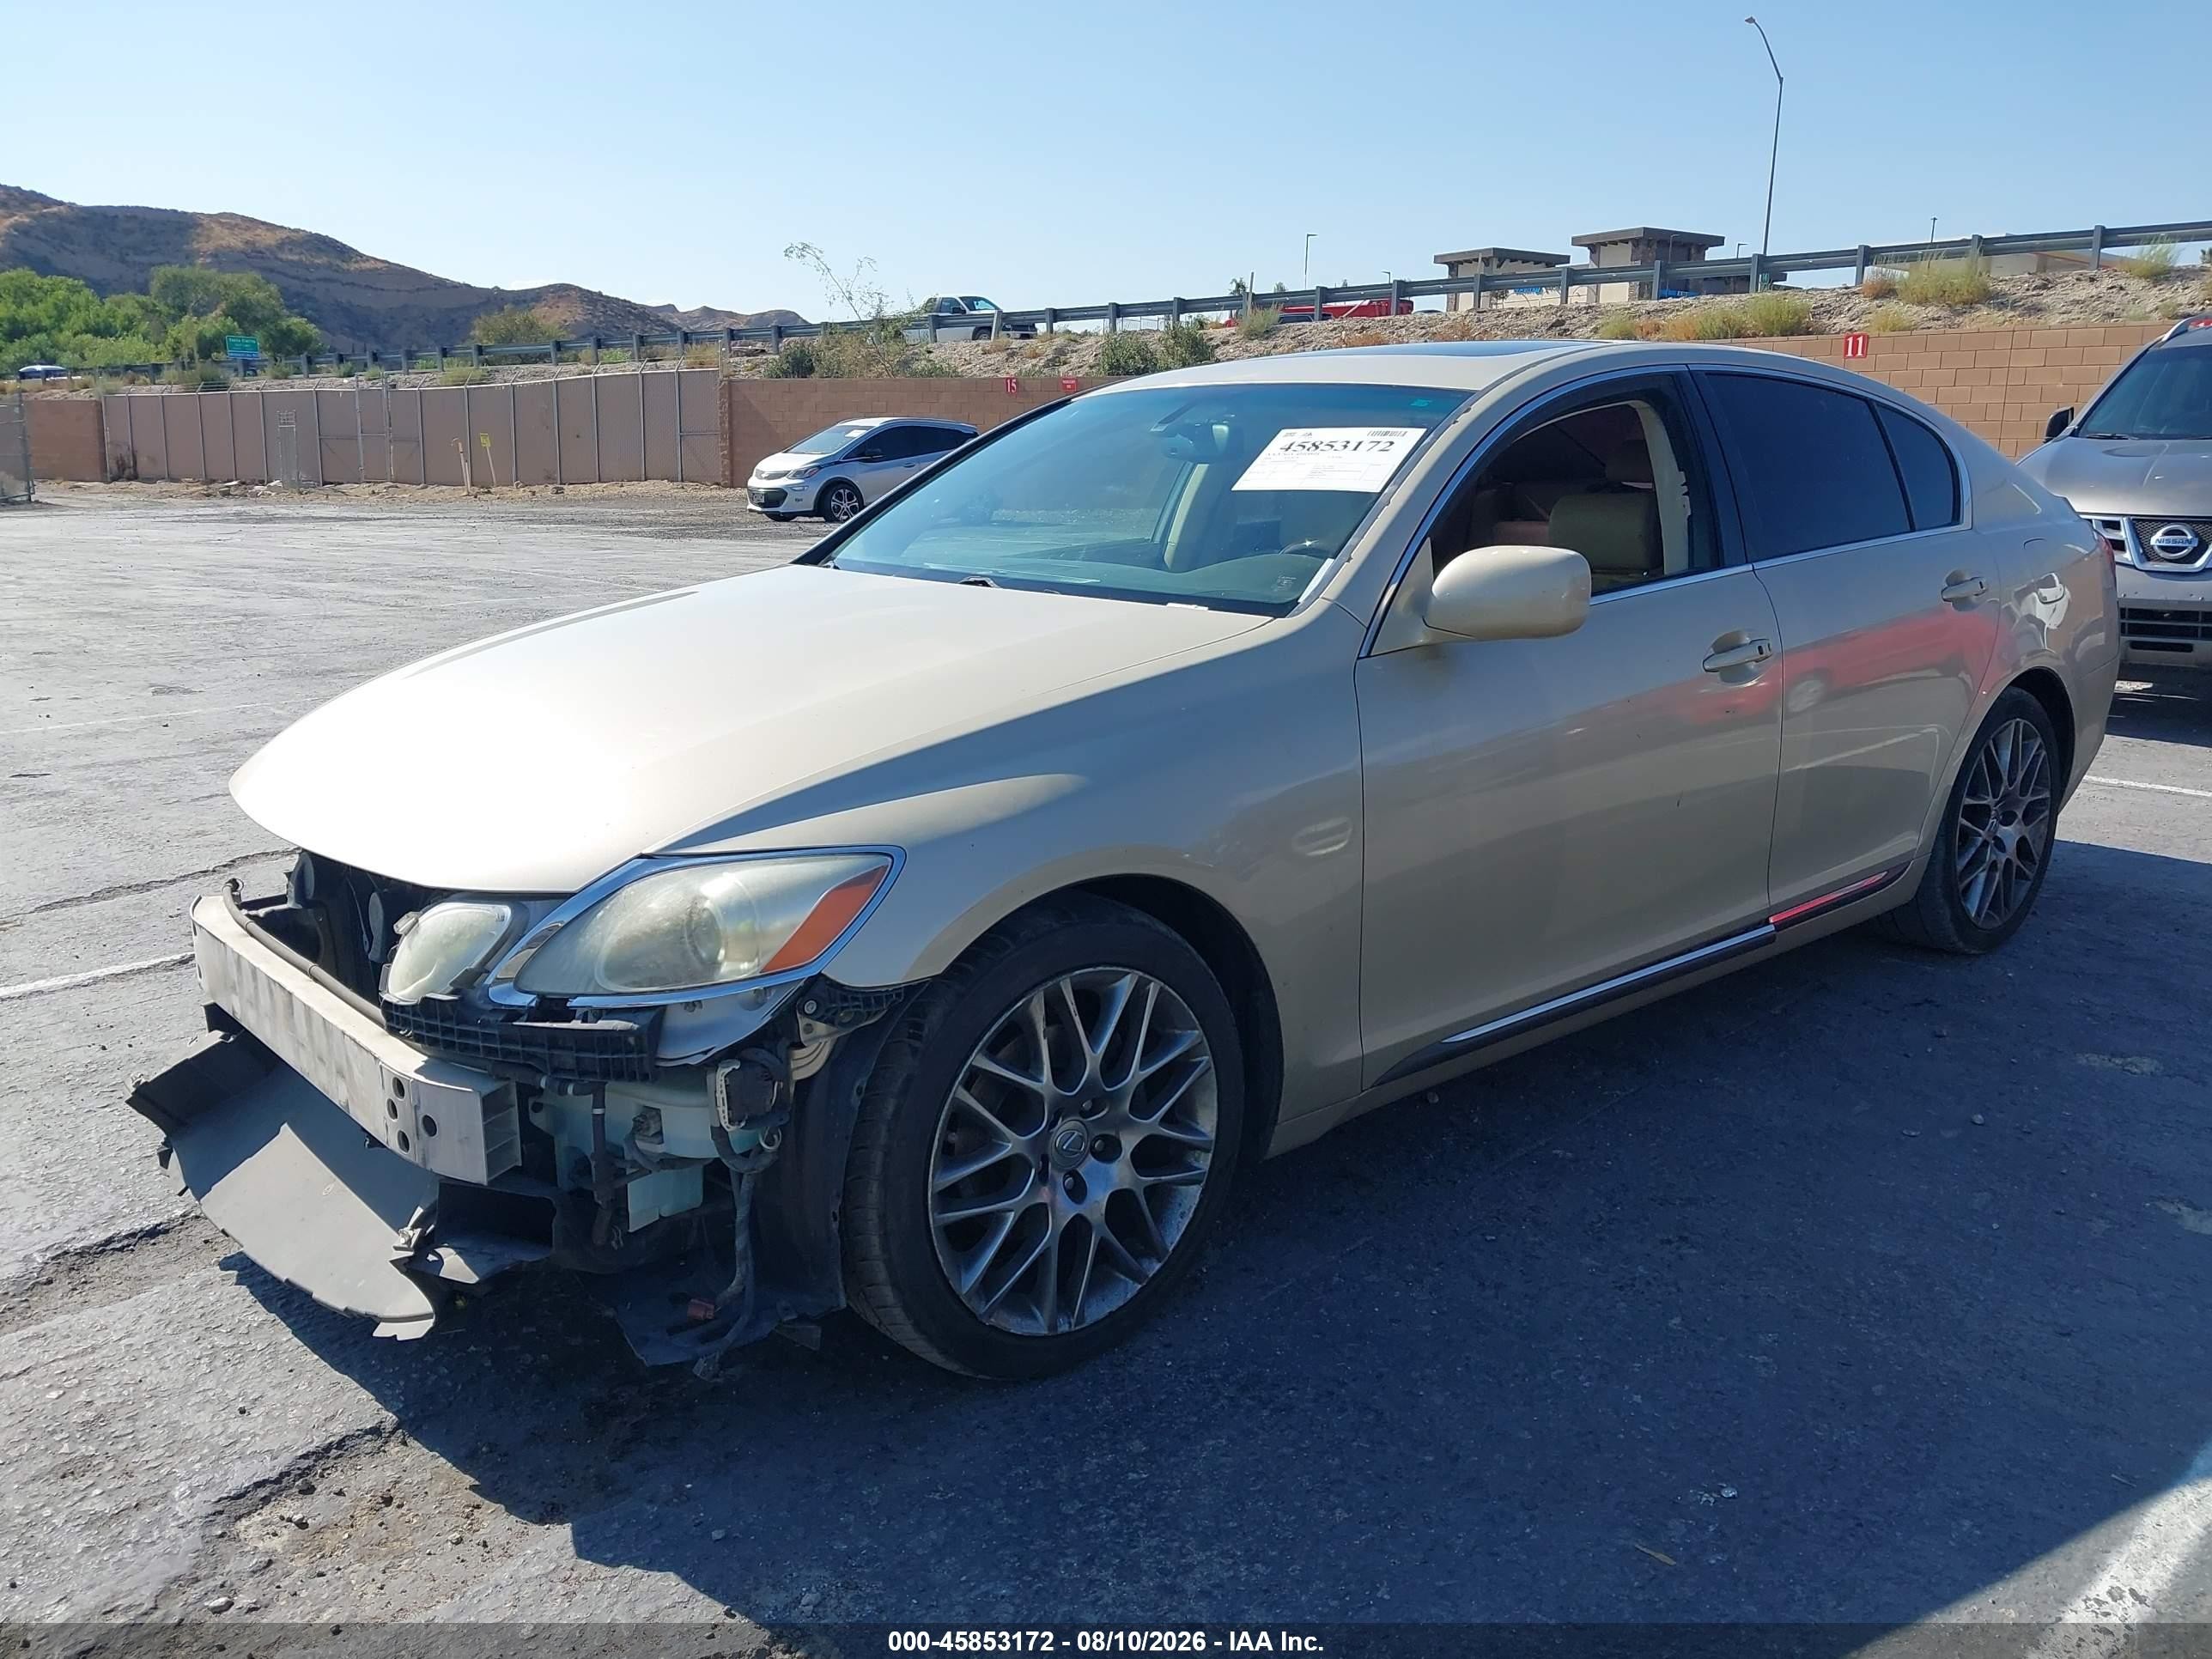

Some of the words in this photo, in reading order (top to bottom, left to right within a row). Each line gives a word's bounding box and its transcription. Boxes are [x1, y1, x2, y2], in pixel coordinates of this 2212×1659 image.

[1845, 336, 1863, 357] 11
[1006, 379, 1017, 392] 15
[1279, 440, 1395, 453] 45853172
